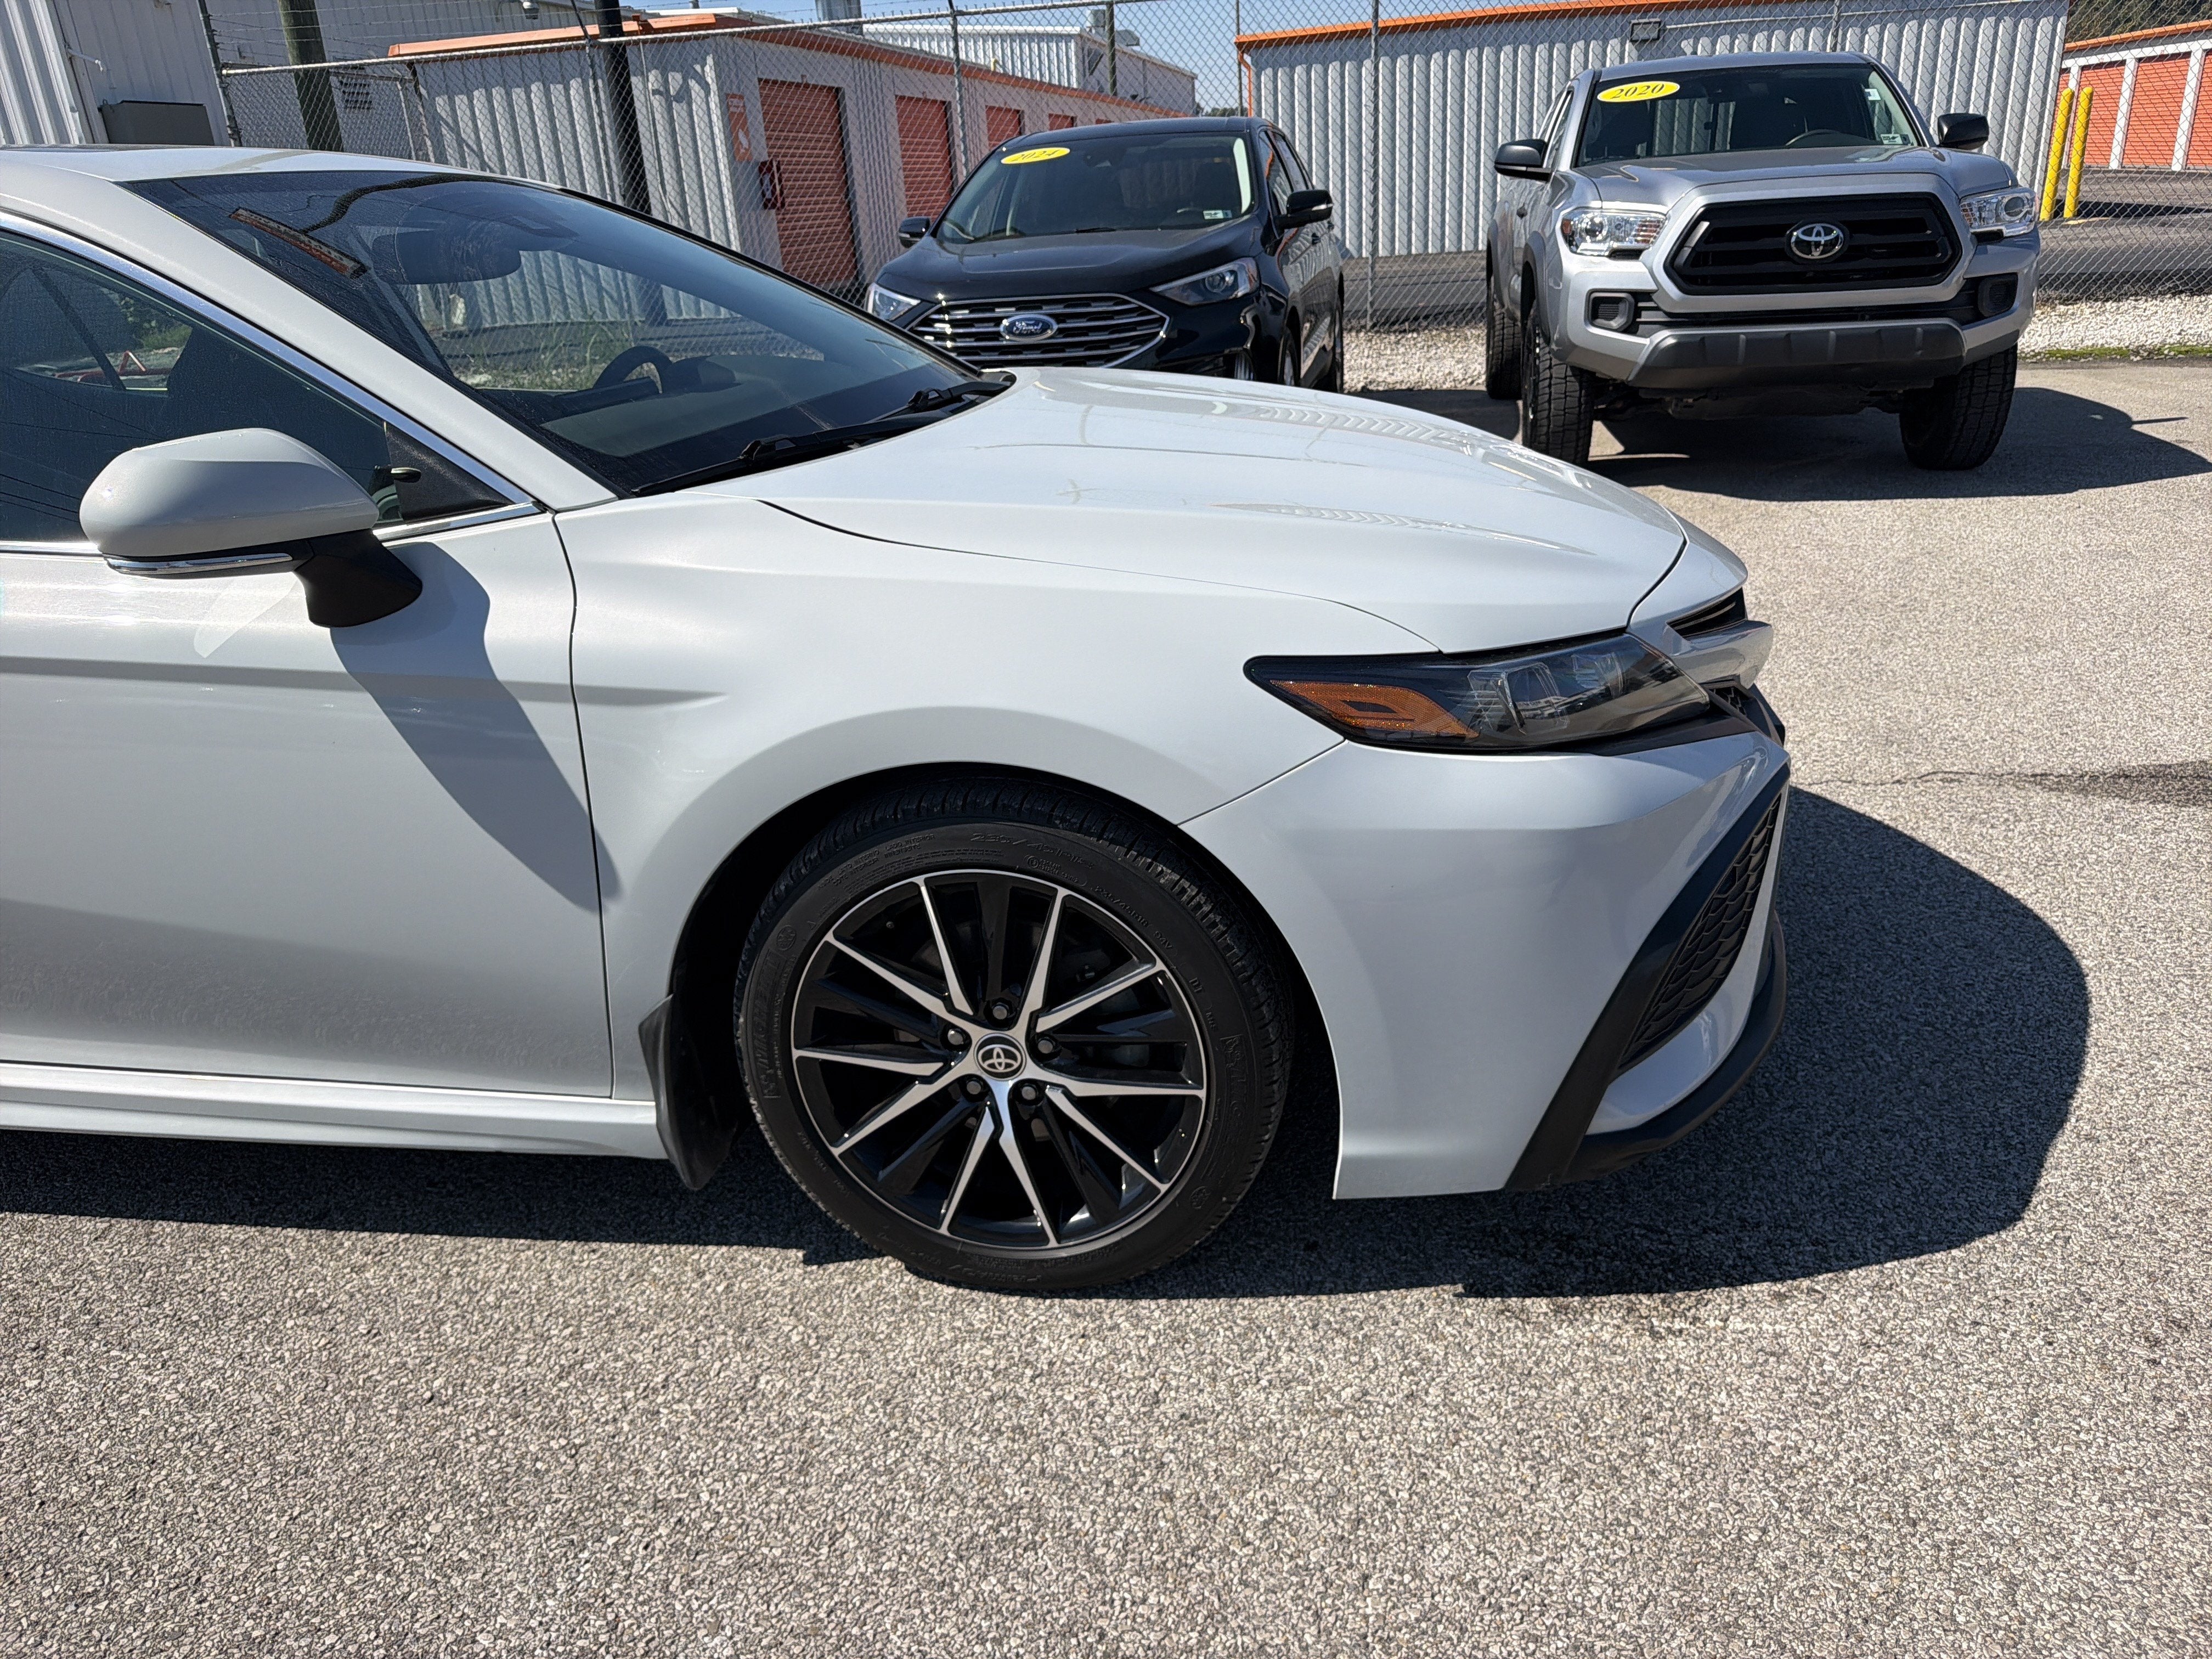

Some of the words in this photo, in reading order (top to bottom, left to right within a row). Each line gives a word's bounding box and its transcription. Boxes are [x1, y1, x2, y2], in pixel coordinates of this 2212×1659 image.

[1610, 83, 1664, 99] 2020
[1012, 321, 1042, 334] Ford
[905, 833, 935, 845] INTERIOR
